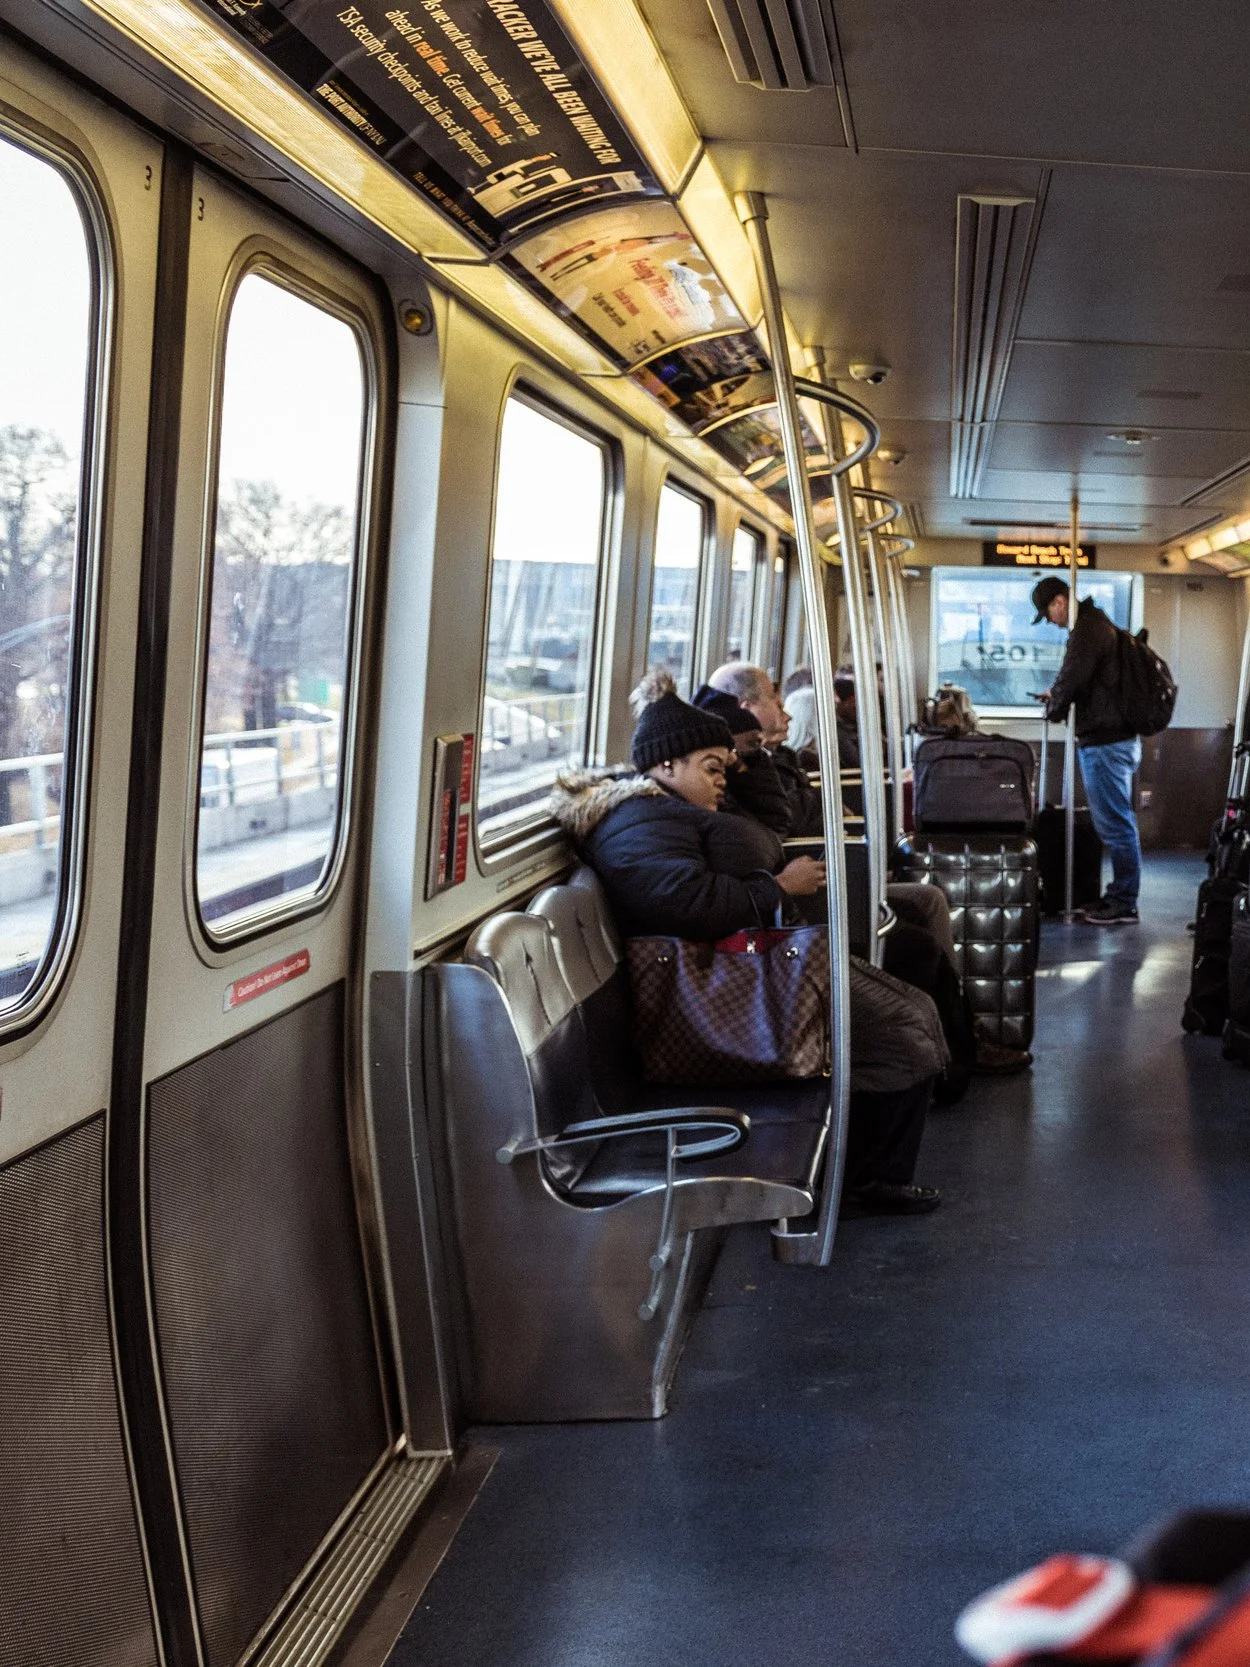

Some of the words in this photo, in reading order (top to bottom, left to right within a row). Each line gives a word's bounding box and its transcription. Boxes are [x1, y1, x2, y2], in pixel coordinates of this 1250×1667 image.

[336, 5, 364, 28] TSA
[385, 9, 422, 36] ahead
[430, 9, 451, 23] we
[350, 23, 387, 57] security
[405, 31, 425, 44] in
[440, 22, 470, 42] work
[413, 41, 442, 59] real
[455, 40, 472, 50] to
[461, 49, 489, 72] reduce
[517, 40, 561, 73] WE'VE
[377, 51, 422, 92] checkpoints
[426, 56, 450, 77] time.
[443, 73, 464, 89] Get
[480, 70, 504, 87] wait
[539, 73, 572, 91] ALL
[412, 89, 439, 104] and
[452, 86, 482, 110] current
[552, 90, 589, 116] BEEN
[424, 100, 449, 115] taxi
[471, 106, 496, 123] wait
[499, 101, 523, 115] you
[434, 109, 456, 129] lines
[513, 113, 531, 125] can
[447, 126, 464, 135] at
[482, 119, 505, 138] times
[516, 123, 541, 136] plan
[569, 114, 612, 150] WAITING
[496, 134, 513, 146] for
[593, 148, 622, 165] FOR
[144, 165, 153, 191] 3
[197, 197, 205, 222] 3
